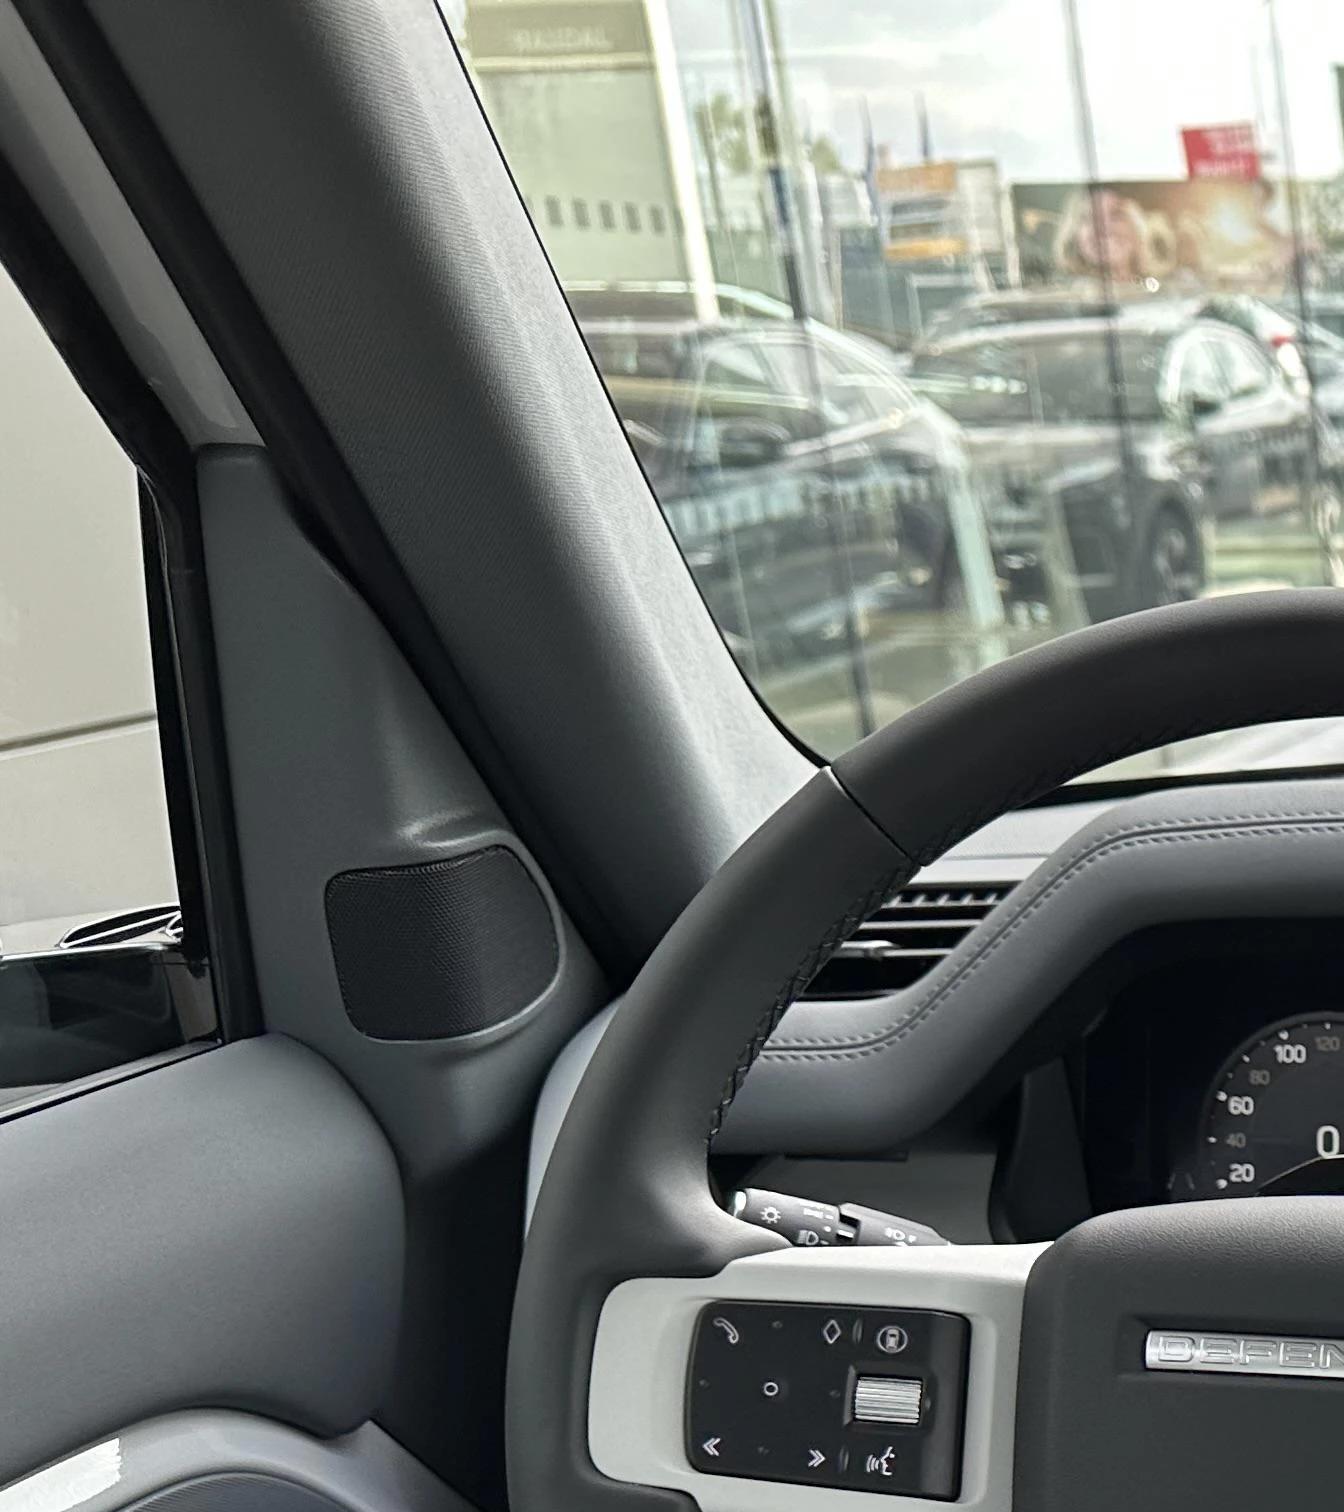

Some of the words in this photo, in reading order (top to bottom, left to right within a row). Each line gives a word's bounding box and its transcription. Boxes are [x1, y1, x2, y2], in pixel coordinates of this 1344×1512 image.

[1314, 1036, 1340, 1051] 120
[1274, 1045, 1306, 1064] 100
[1249, 1070, 1270, 1086] 80
[1228, 1096, 1254, 1115] 60
[1226, 1133, 1246, 1148] 40
[1316, 1125, 1340, 1158] 0
[1229, 1163, 1255, 1183] 20
